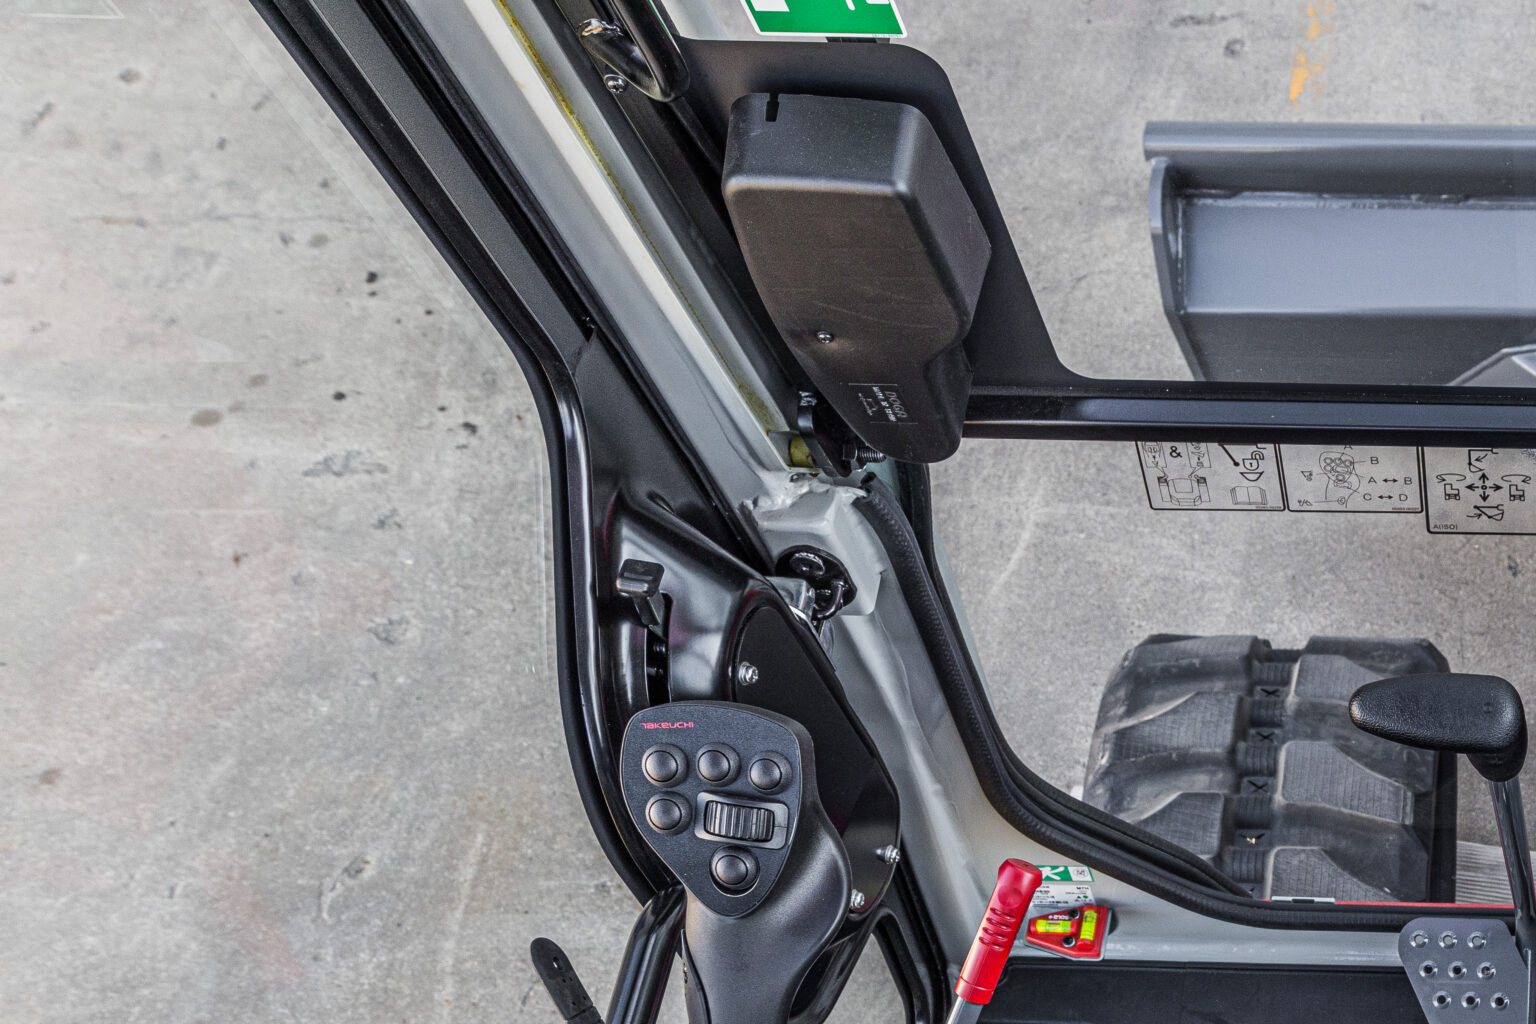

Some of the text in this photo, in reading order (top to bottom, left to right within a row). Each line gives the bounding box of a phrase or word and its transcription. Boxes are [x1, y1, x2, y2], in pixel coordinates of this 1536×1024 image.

[1370, 456, 1380, 465] B
[1368, 476, 1413, 485] A B
[1363, 493, 1408, 502] C D
[641, 721, 694, 729] TAKEUCHI
